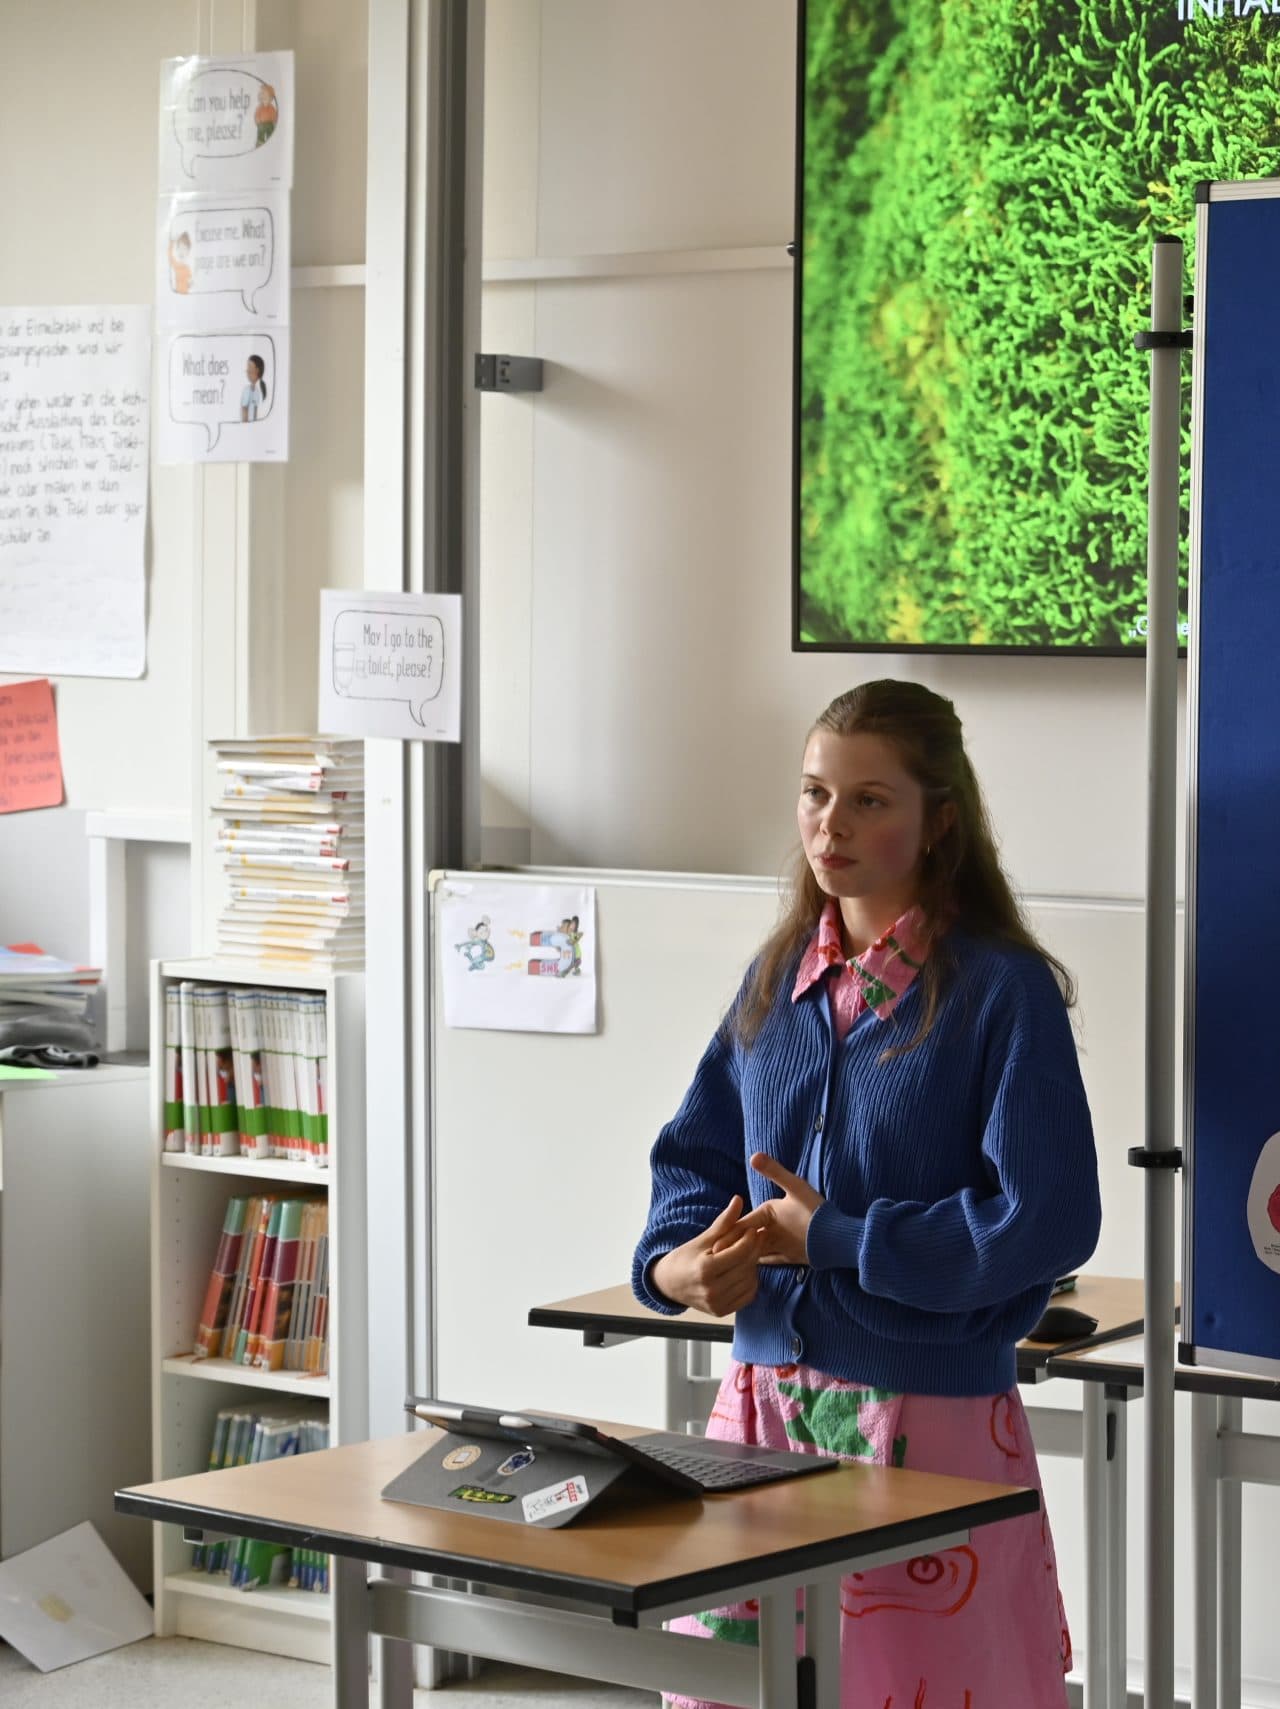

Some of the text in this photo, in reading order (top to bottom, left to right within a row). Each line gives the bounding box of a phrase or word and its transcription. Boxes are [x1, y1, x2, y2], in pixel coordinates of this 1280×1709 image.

[209, 95, 226, 113] you
[229, 87, 250, 115] help
[207, 113, 243, 147] please?
[242, 217, 265, 239] What
[232, 254, 246, 267] we
[248, 244, 266, 267] on?
[182, 352, 229, 376] What does
[193, 378, 225, 405] mean?
[391, 633, 401, 653] go
[405, 627, 414, 648] to
[417, 628, 433, 649] the
[368, 655, 433, 683] toilet, please?
